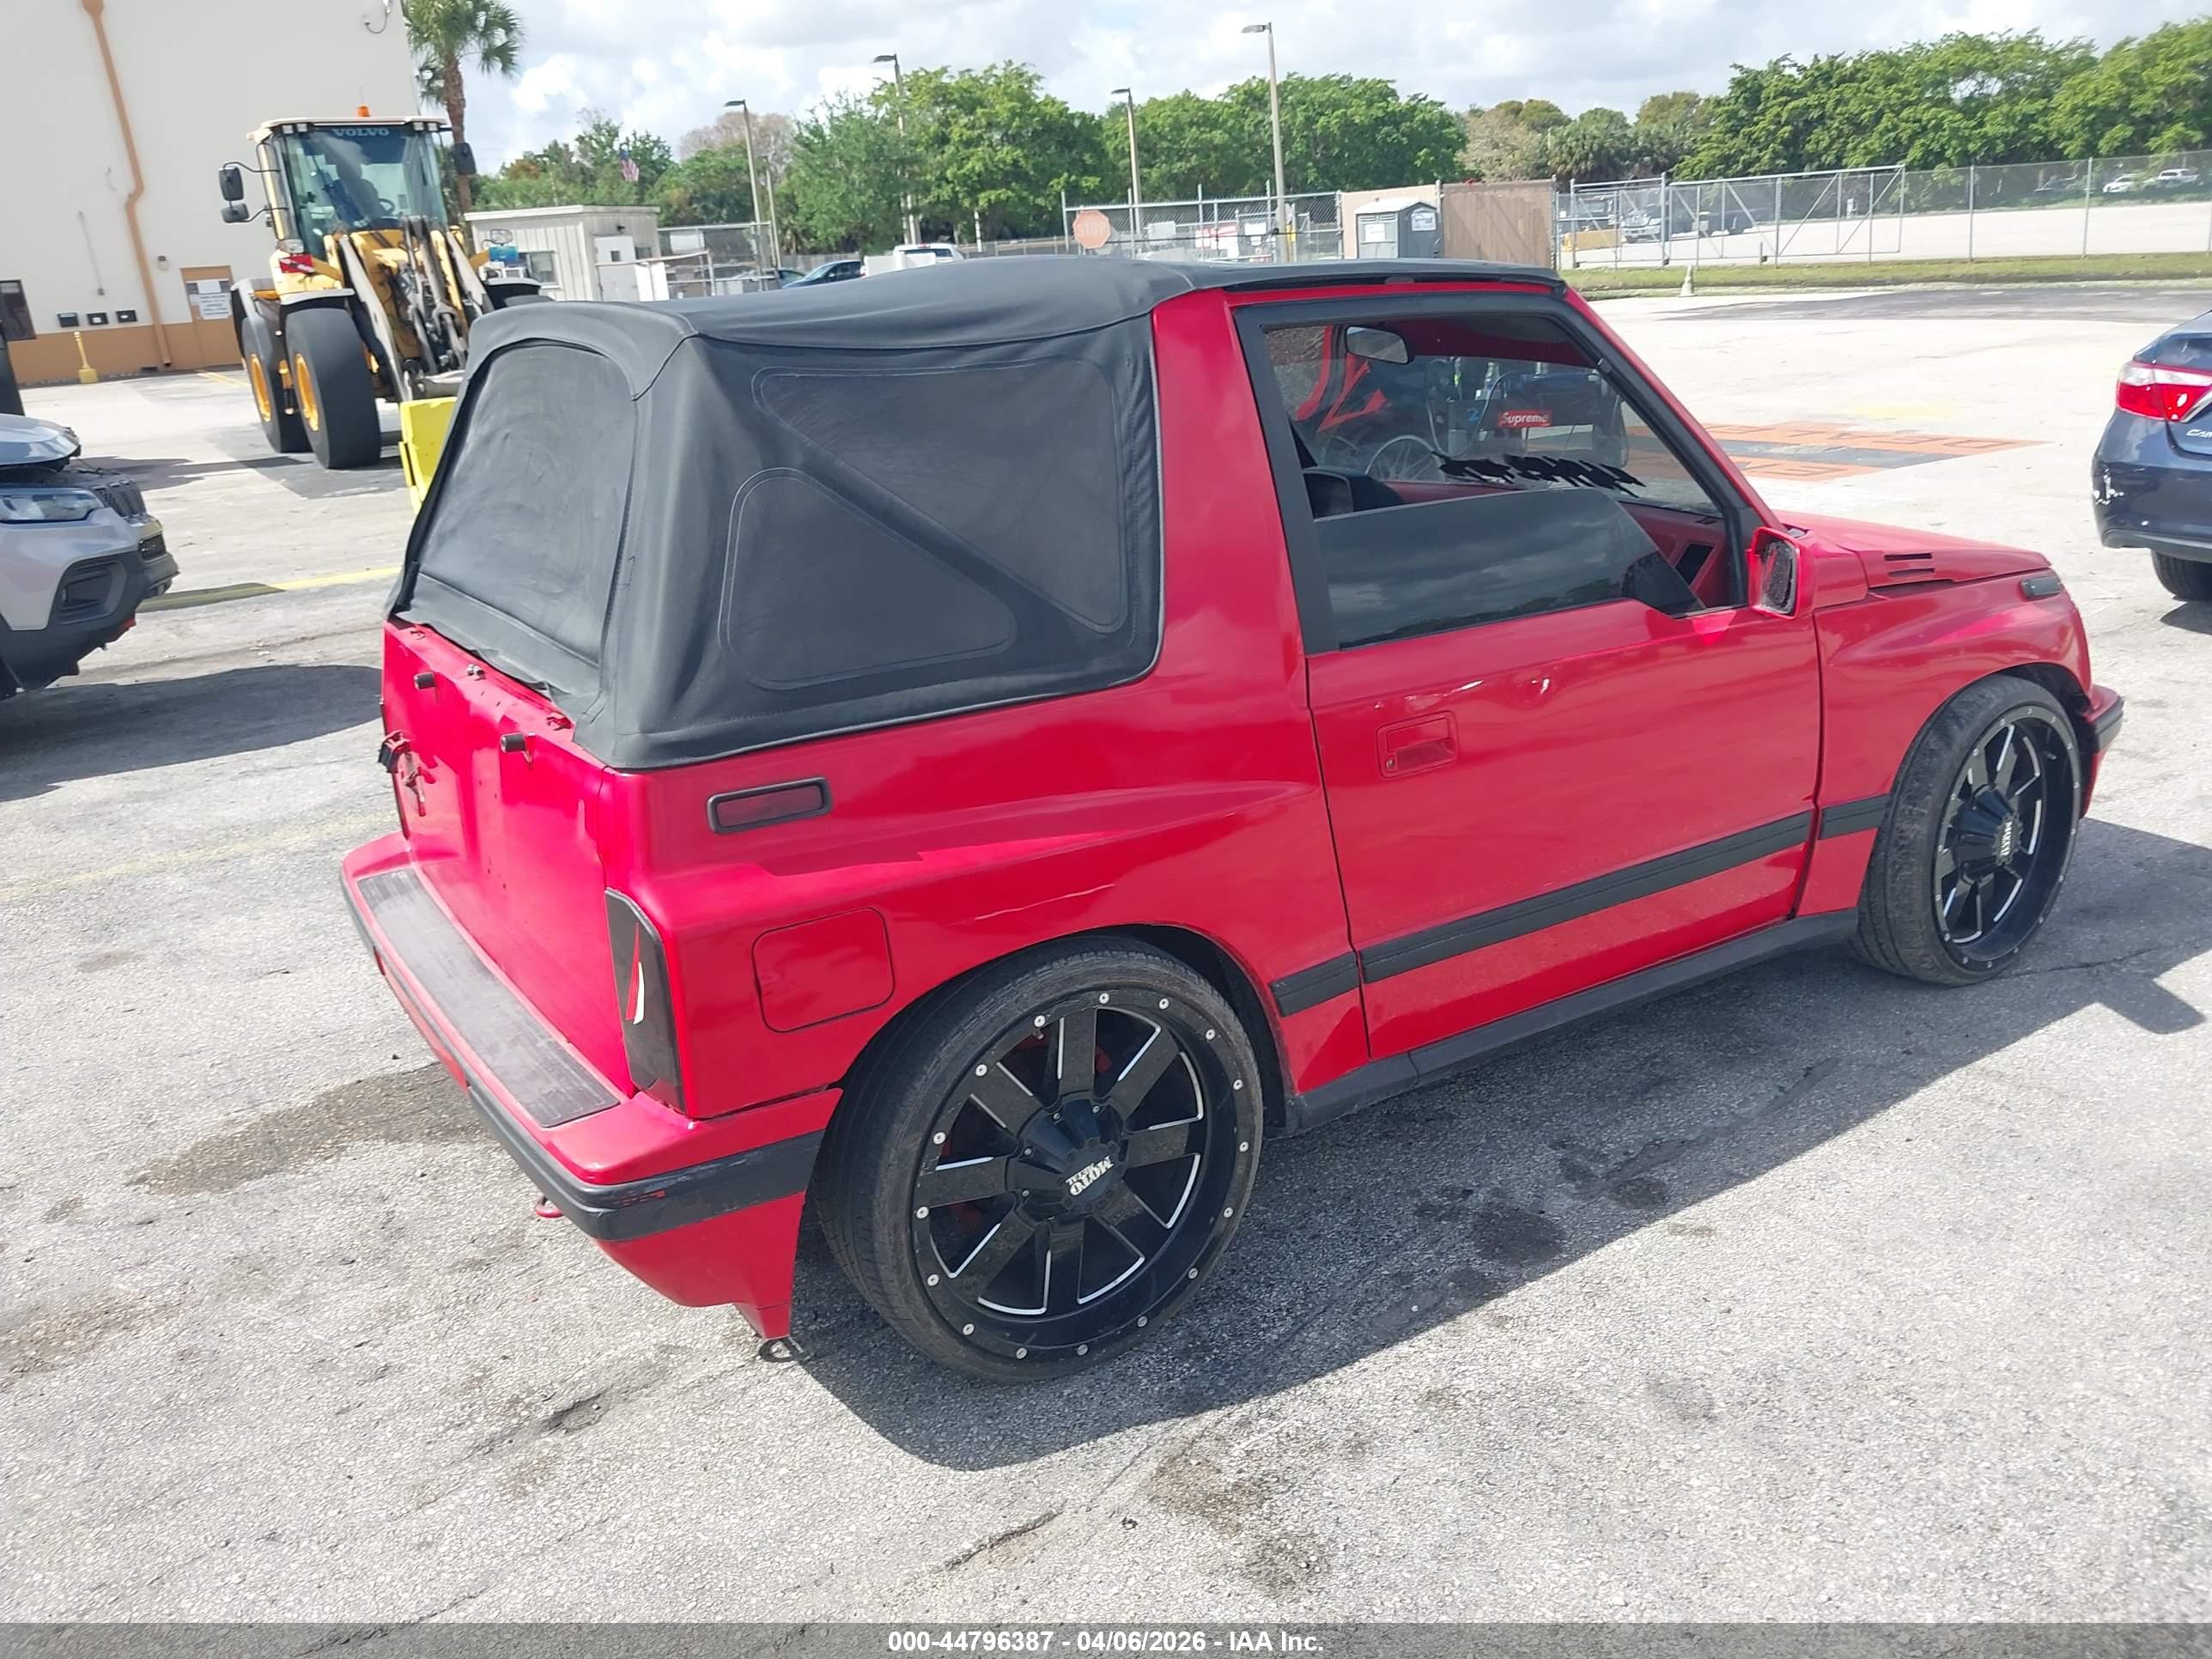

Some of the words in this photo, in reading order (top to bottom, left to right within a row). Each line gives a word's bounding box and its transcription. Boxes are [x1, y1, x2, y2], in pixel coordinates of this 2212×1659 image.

[331, 128, 390, 137] VOLVO
[1502, 412, 1549, 426] Supreme
[1070, 1155, 1115, 1196] MOTO
